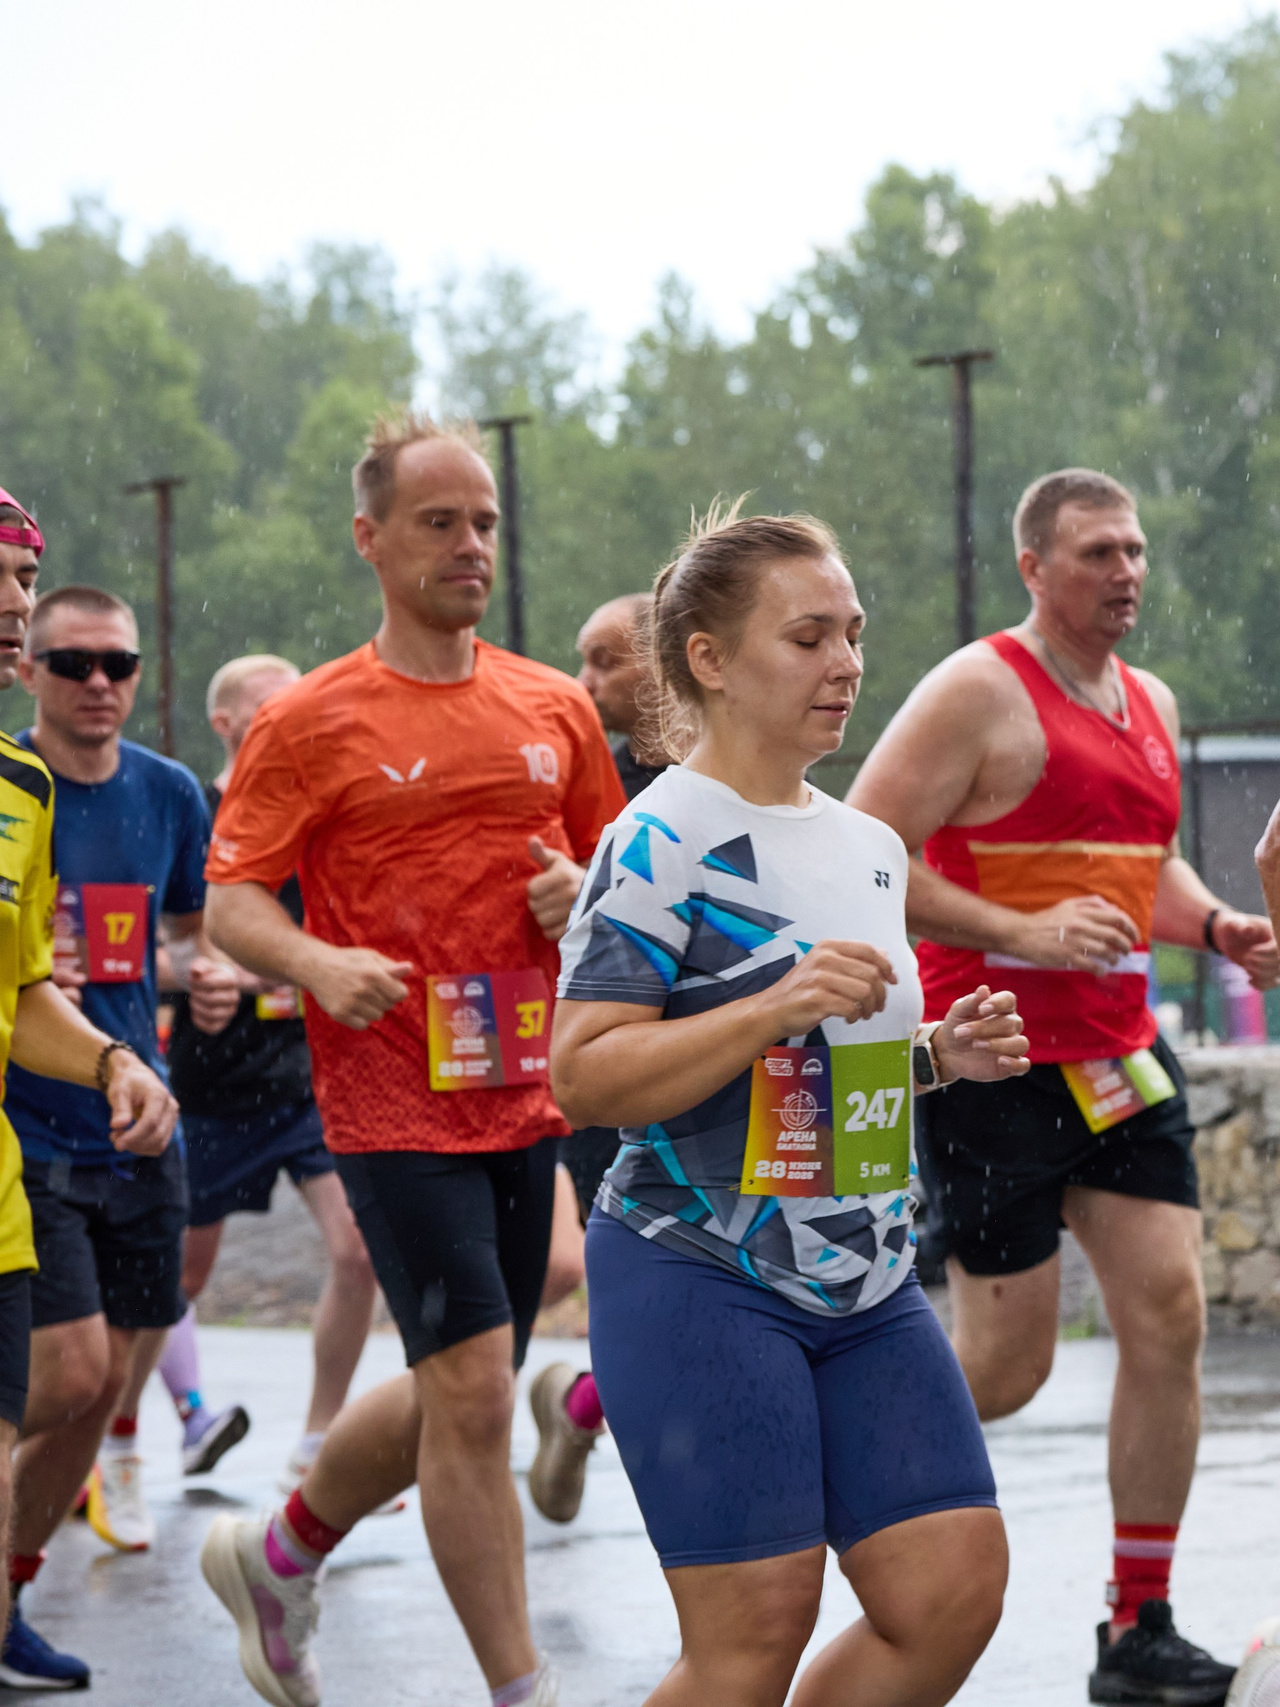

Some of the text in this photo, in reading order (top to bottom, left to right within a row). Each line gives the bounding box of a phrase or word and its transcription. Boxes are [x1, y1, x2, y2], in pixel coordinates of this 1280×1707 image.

[518, 742, 558, 785] 10
[104, 913, 136, 944] 17
[515, 1000, 546, 1039] 37
[844, 1087, 906, 1133] 247
[778, 1131, 816, 1142] АРЕНА
[754, 1160, 787, 1178] 28
[859, 1162, 891, 1178] 5 КМ
